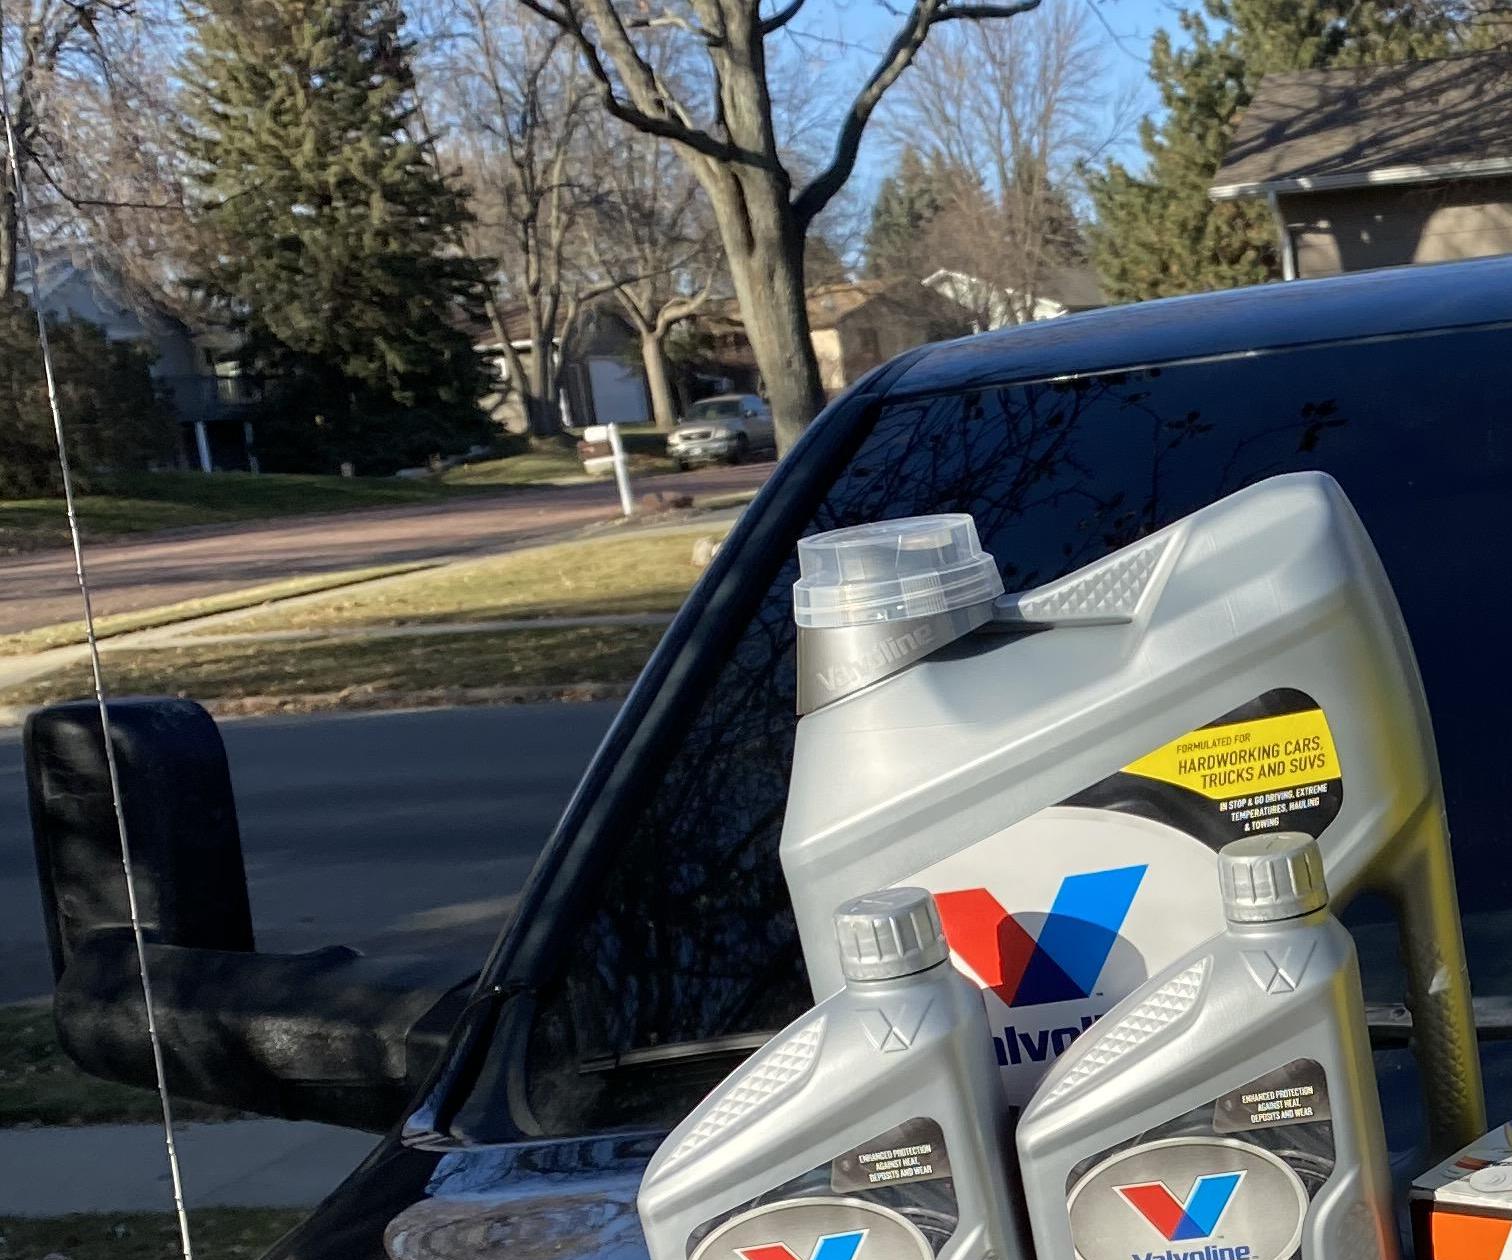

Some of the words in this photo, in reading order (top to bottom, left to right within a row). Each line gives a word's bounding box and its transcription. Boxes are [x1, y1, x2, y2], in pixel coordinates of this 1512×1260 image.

[1176, 736, 1232, 754] FORMULATED
[1234, 733, 1251, 745] FOR
[1178, 745, 1280, 775] HARDWORKING
[1285, 736, 1323, 755] CARS,
[1201, 767, 1254, 790] TRUCKS
[1258, 761, 1285, 779] AND
[1290, 754, 1325, 773] SUVS
[1229, 798, 1246, 810] STOP
[1255, 796, 1264, 808] GO
[1296, 783, 1328, 797] EXTREME
